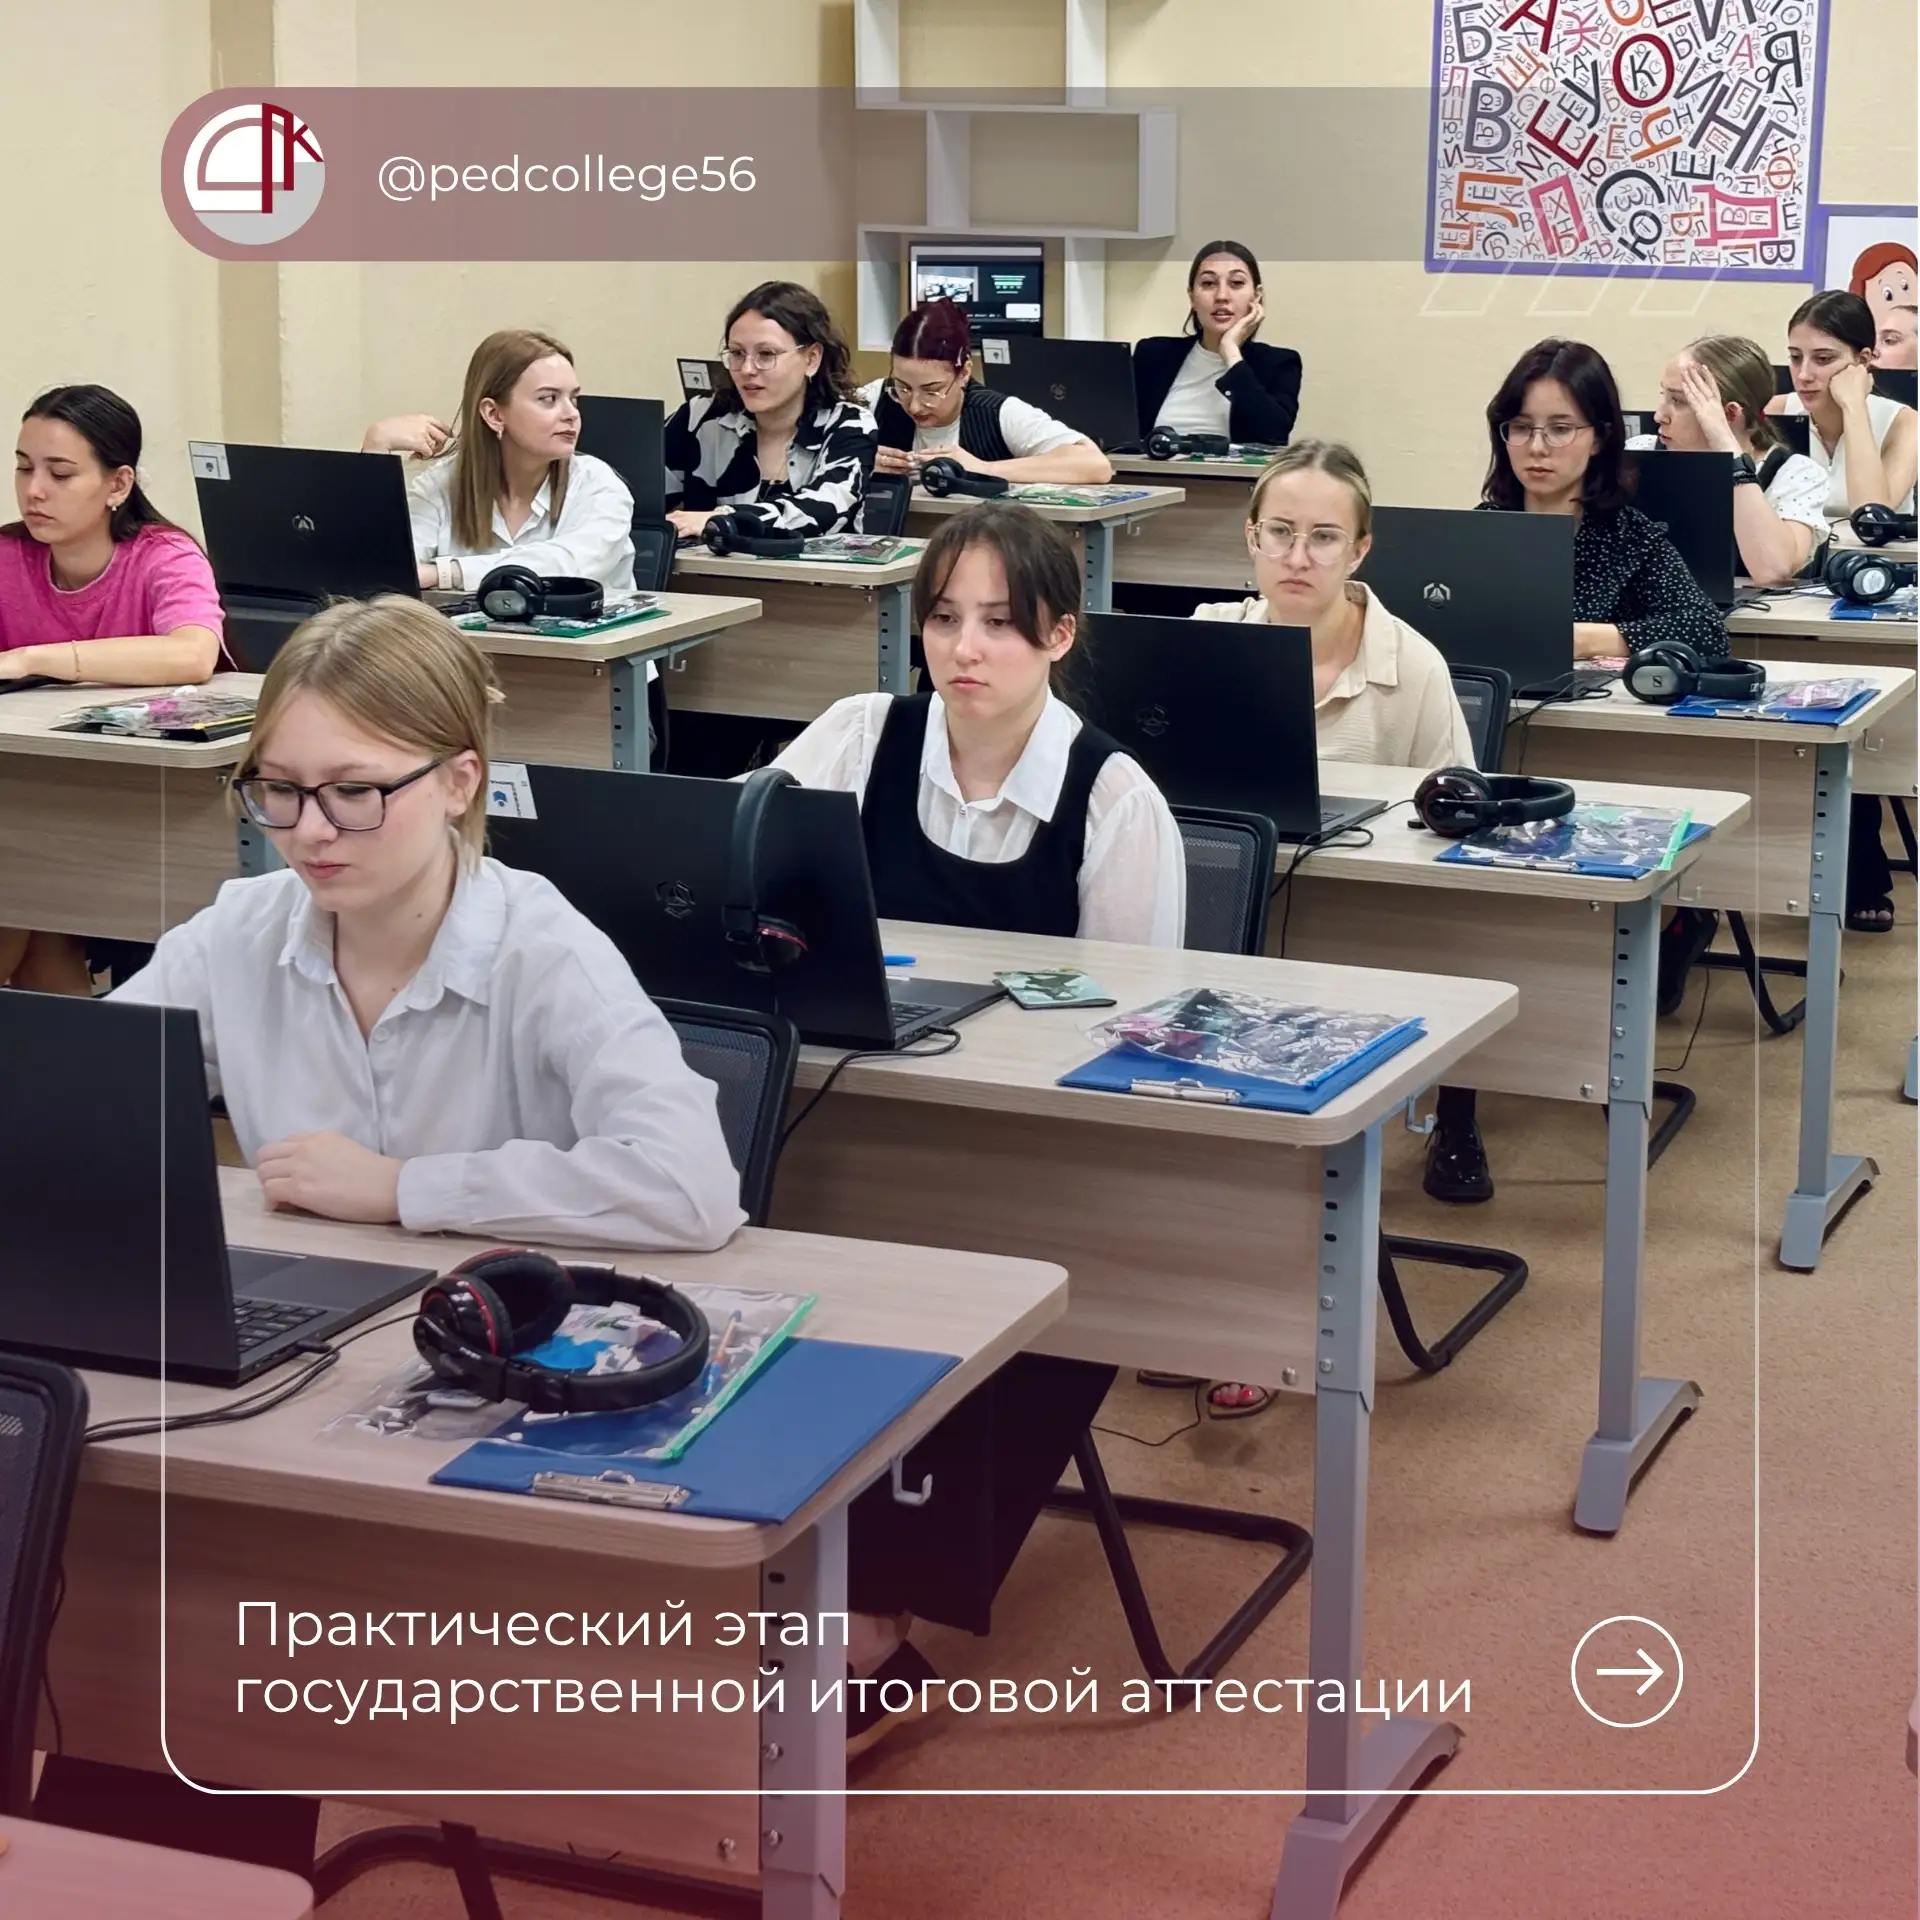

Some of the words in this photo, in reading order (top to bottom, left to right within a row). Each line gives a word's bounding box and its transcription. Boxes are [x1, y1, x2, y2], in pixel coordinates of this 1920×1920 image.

[1613, 33, 1674, 108] О
[1764, 30, 1803, 93] Я
[1464, 80, 1513, 155] В
[1688, 84, 1767, 170] Н
